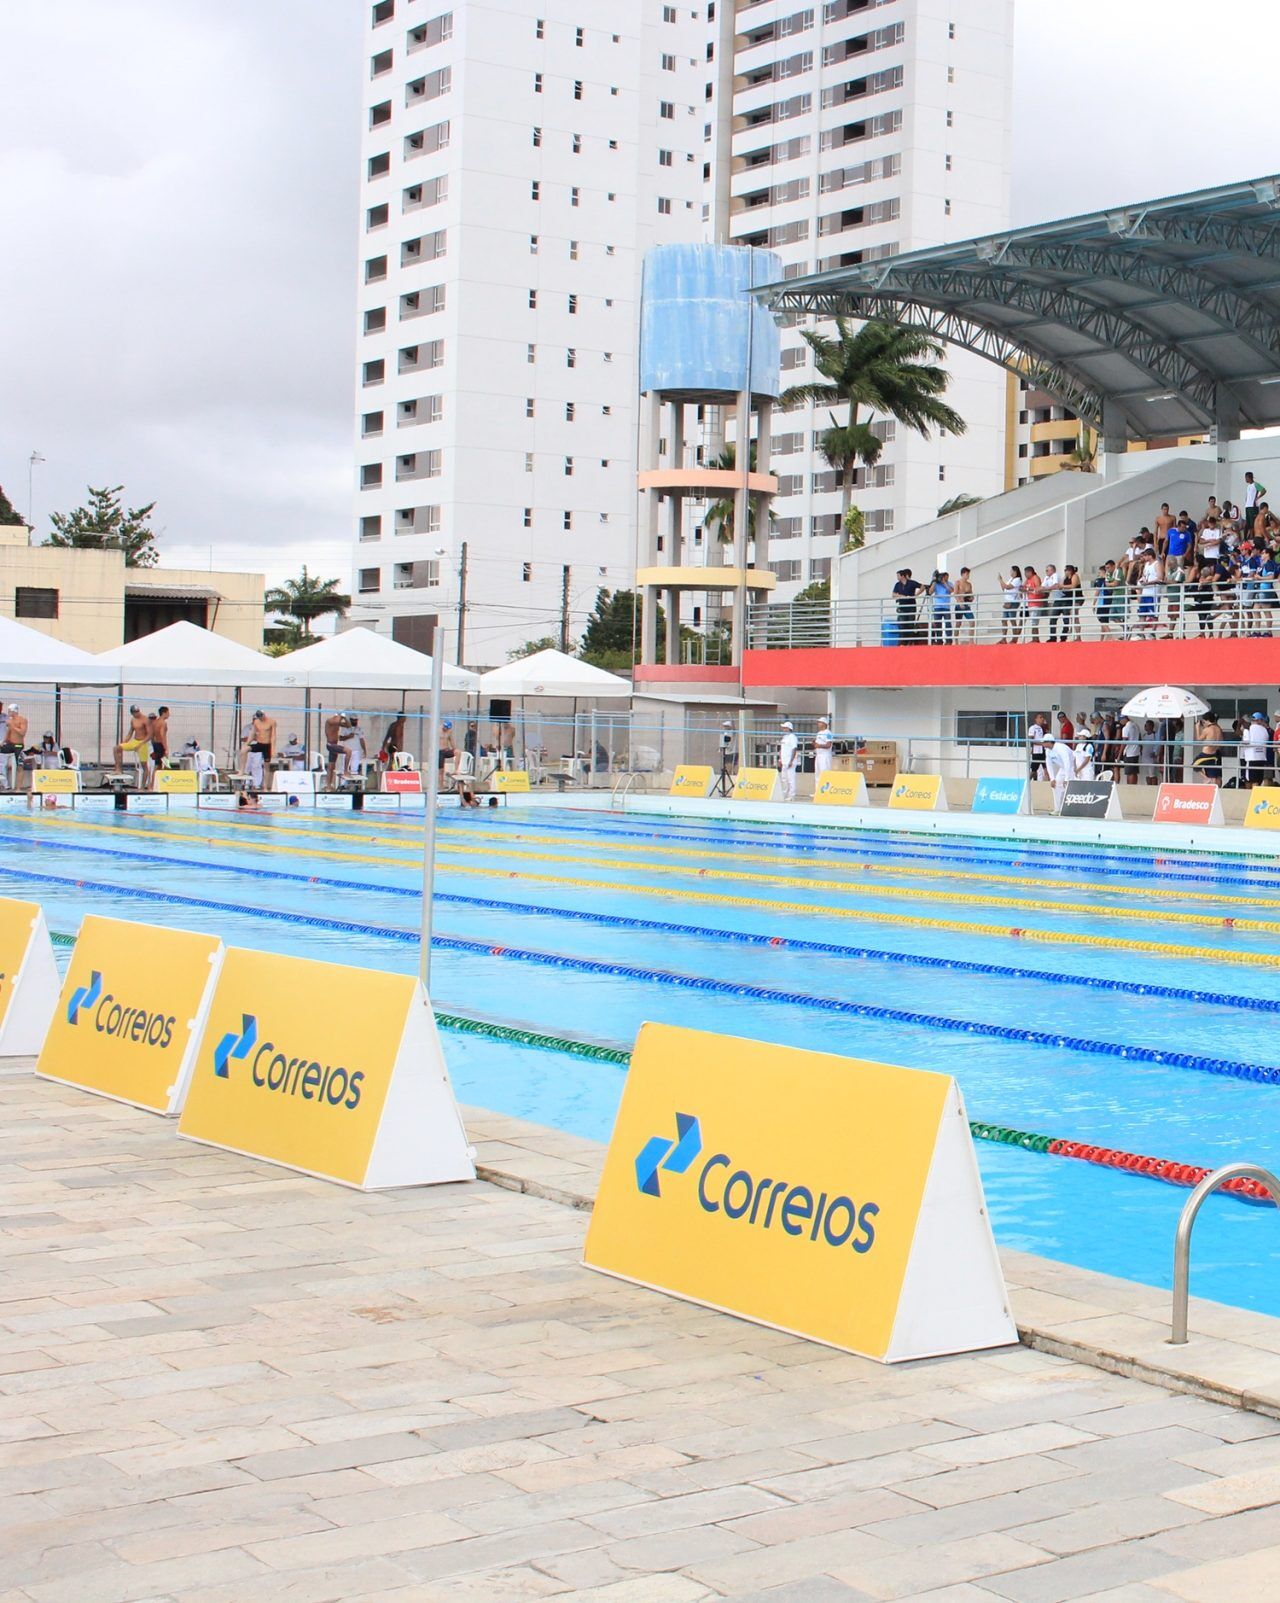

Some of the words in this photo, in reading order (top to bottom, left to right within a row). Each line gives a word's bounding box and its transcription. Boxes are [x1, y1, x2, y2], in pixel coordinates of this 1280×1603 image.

[682, 778, 703, 788] Correios
[829, 785, 853, 796] Correios
[905, 789, 932, 800] Correios
[1173, 798, 1210, 810] Bradesco
[95, 993, 177, 1049] Correios
[252, 1042, 366, 1110] Correios
[698, 1153, 881, 1254] Correios
